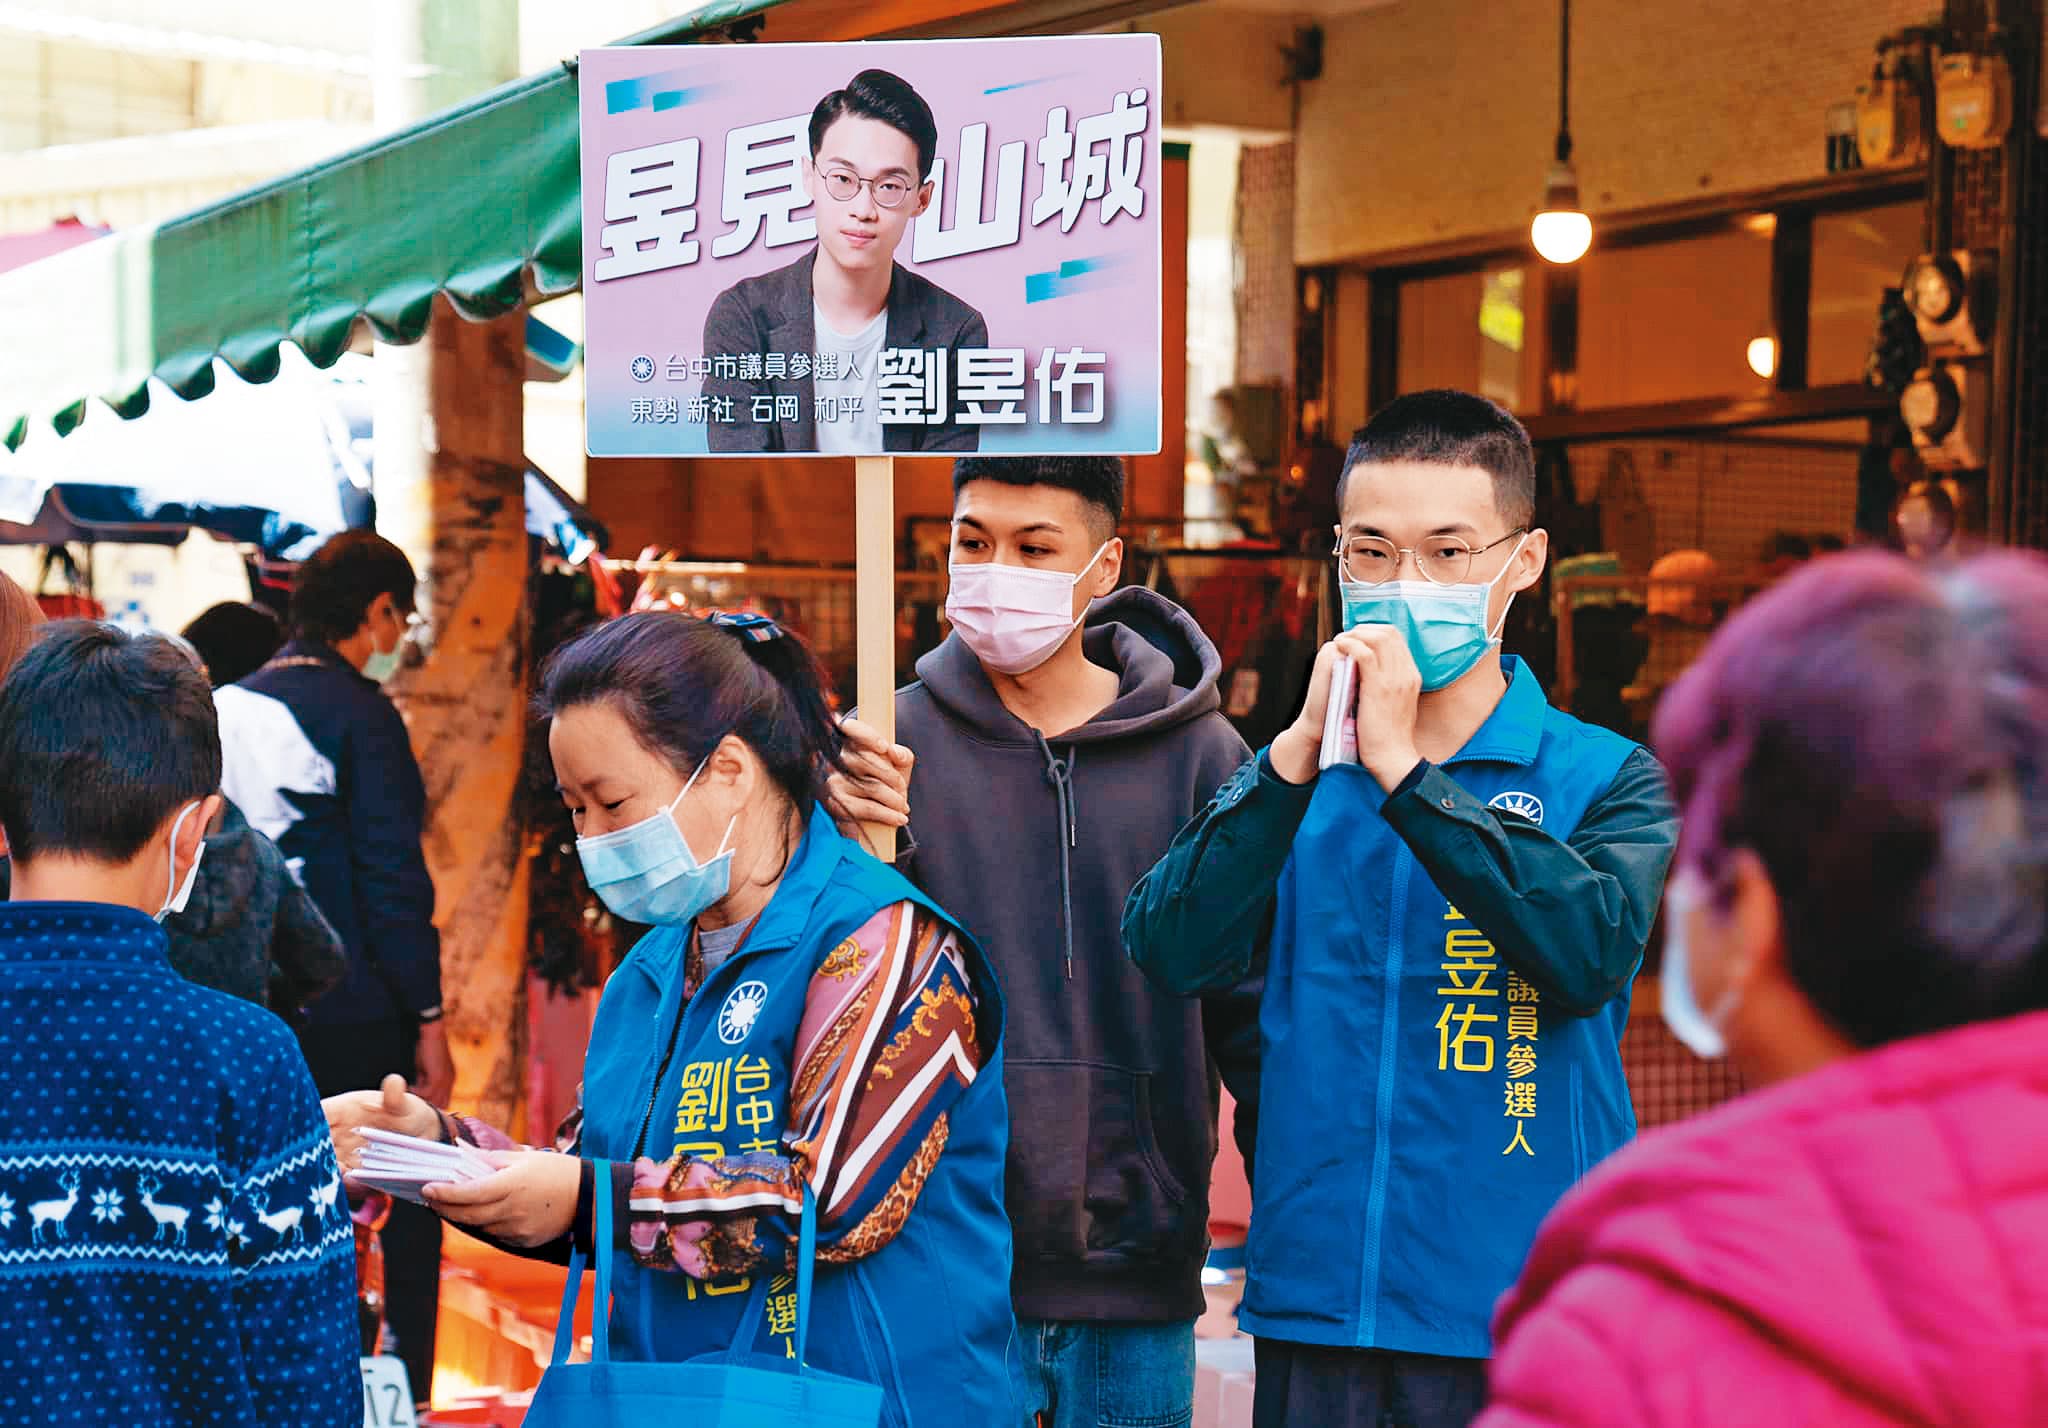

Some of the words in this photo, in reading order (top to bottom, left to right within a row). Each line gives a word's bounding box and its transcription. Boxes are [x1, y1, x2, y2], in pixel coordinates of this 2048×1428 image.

[664, 352, 863, 381] 台中市議員參選人
[876, 345, 1107, 425] 劉昱佑
[631, 396, 679, 423] 東勢
[687, 395, 735, 423] 新社
[750, 395, 799, 423] 石岡
[814, 395, 864, 423] 和平
[1435, 901, 1499, 1072] 昱佑
